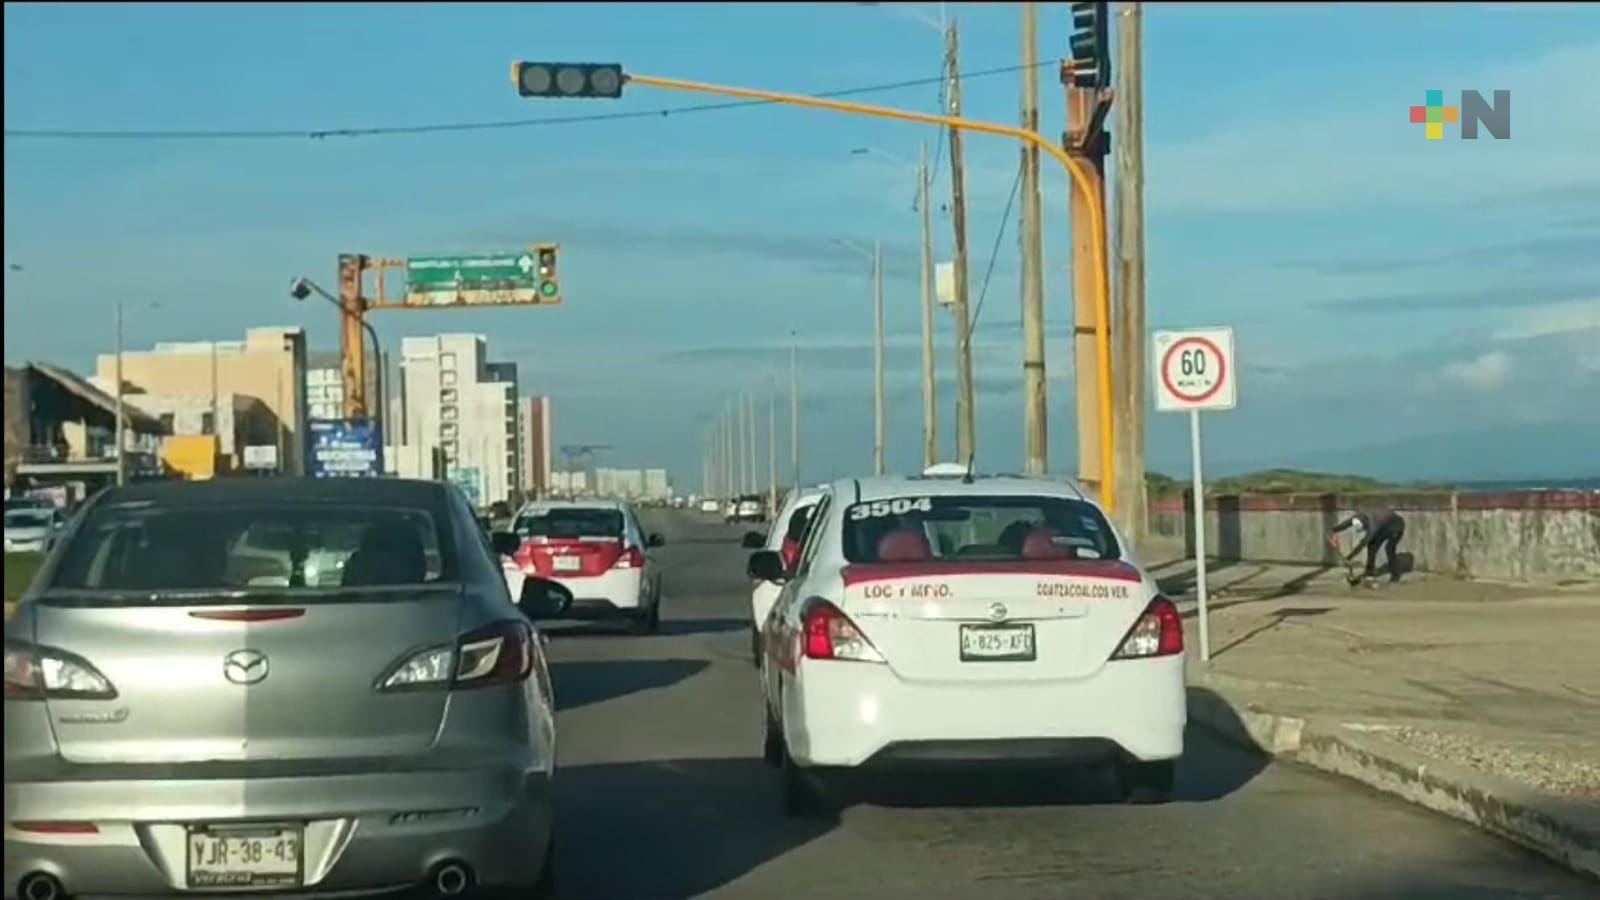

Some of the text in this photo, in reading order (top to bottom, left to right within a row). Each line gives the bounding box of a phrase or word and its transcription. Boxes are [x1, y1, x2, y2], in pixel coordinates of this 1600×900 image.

[1181, 348, 1206, 375] 60
[850, 498, 931, 520] 3504
[194, 839, 297, 865] YJR-38-43
